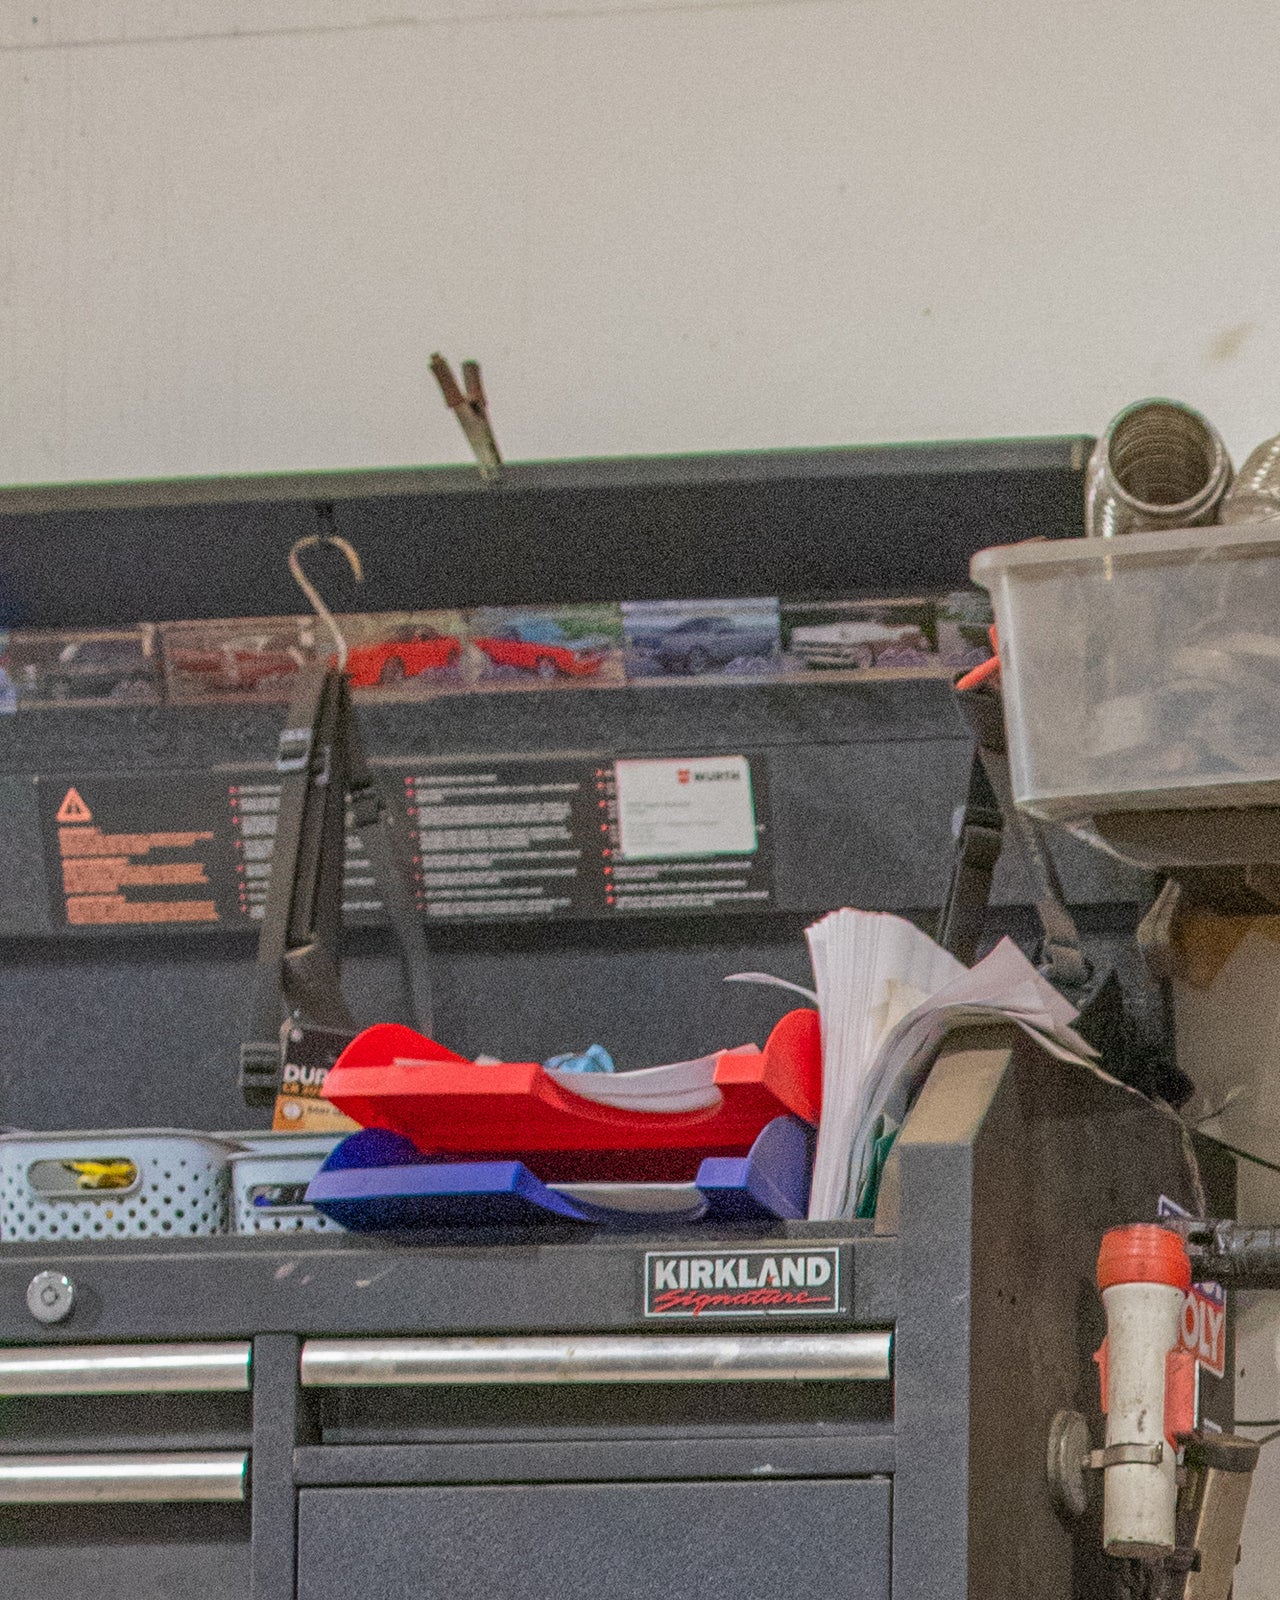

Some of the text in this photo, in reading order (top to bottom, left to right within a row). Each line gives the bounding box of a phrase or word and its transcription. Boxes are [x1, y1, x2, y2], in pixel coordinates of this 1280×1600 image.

[283, 1063, 330, 1085] DUR
[655, 1257, 831, 1290] KIRKLAND
[654, 1288, 831, 1316] Signature
[1180, 1291, 1223, 1362] OLY
